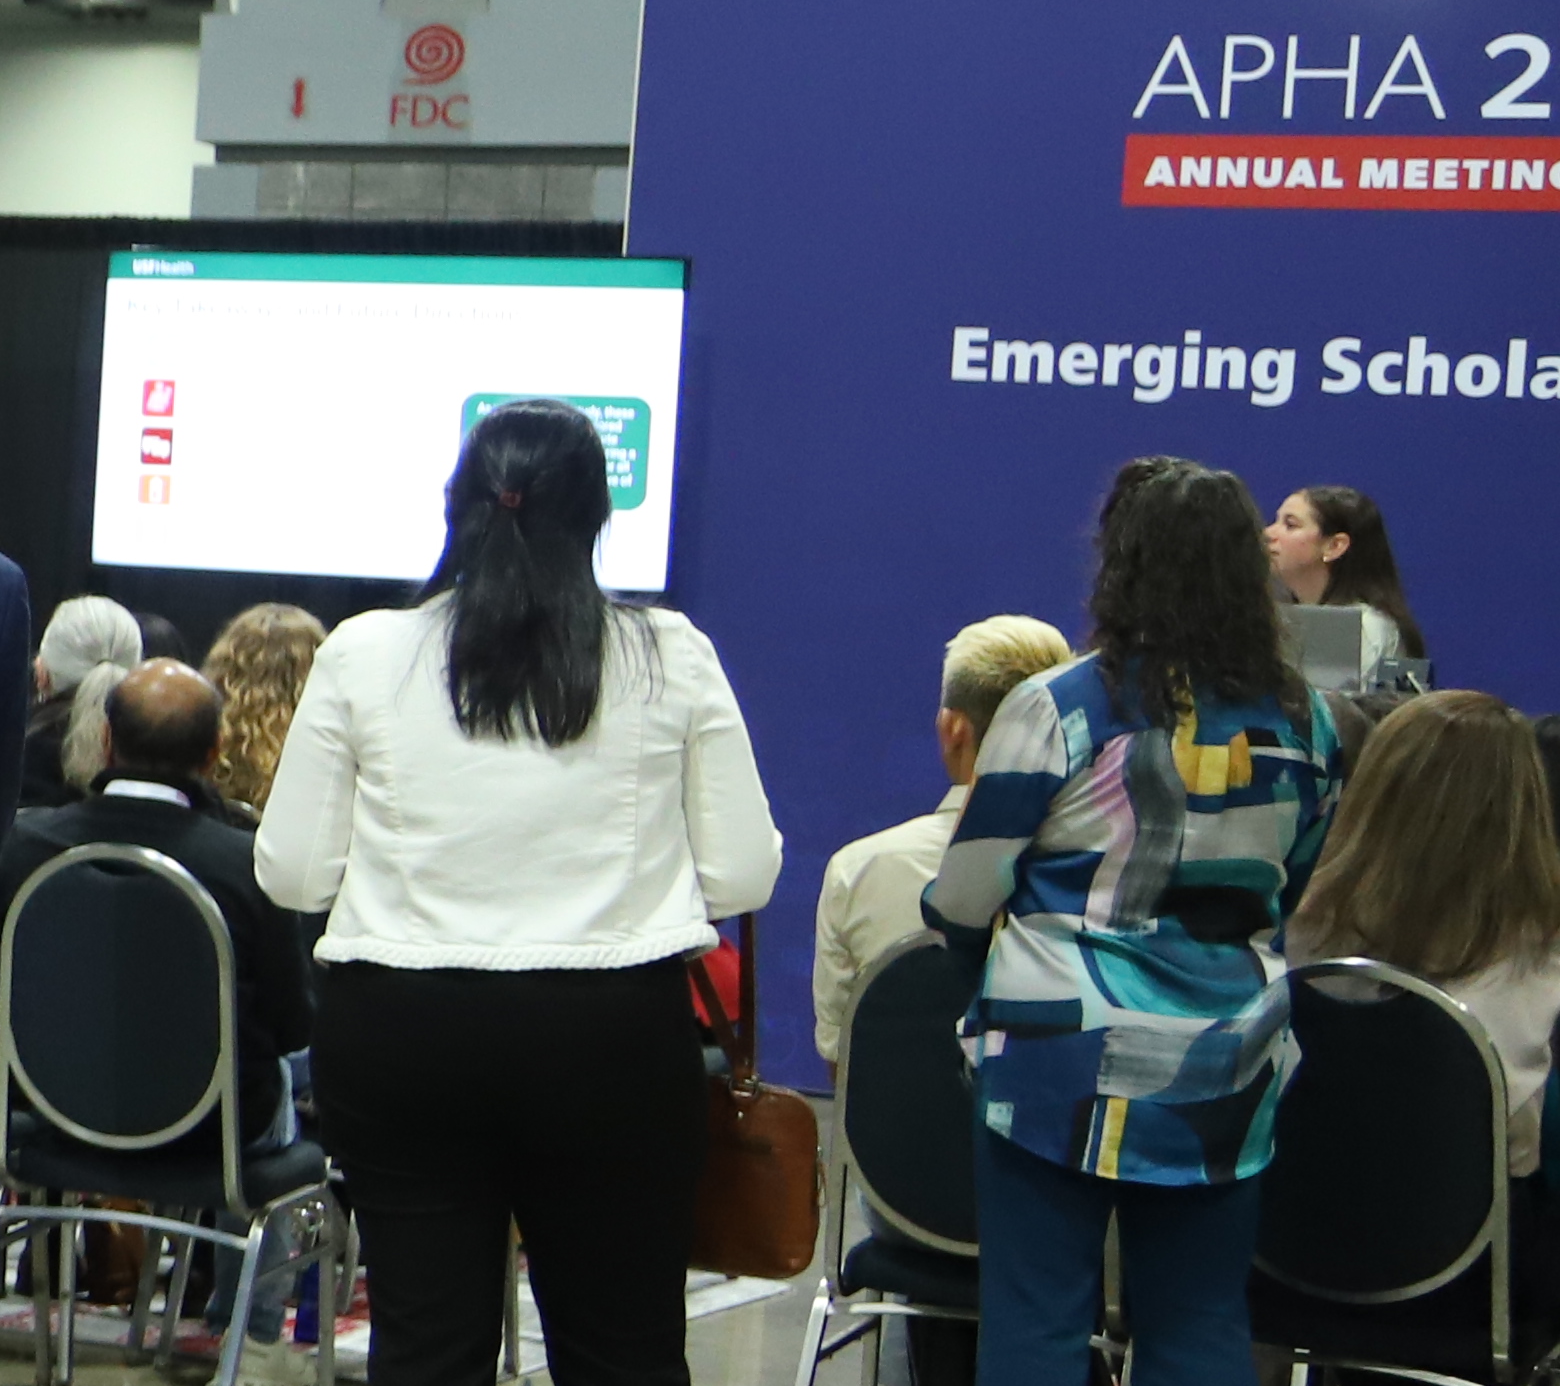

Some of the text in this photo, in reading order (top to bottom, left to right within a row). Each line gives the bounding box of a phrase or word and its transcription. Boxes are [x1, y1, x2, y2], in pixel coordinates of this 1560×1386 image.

[1132, 34, 1446, 120] APHA
[389, 93, 470, 131] FDC
[1143, 155, 1344, 189] ANNUAL
[950, 326, 1296, 421] Emerging
